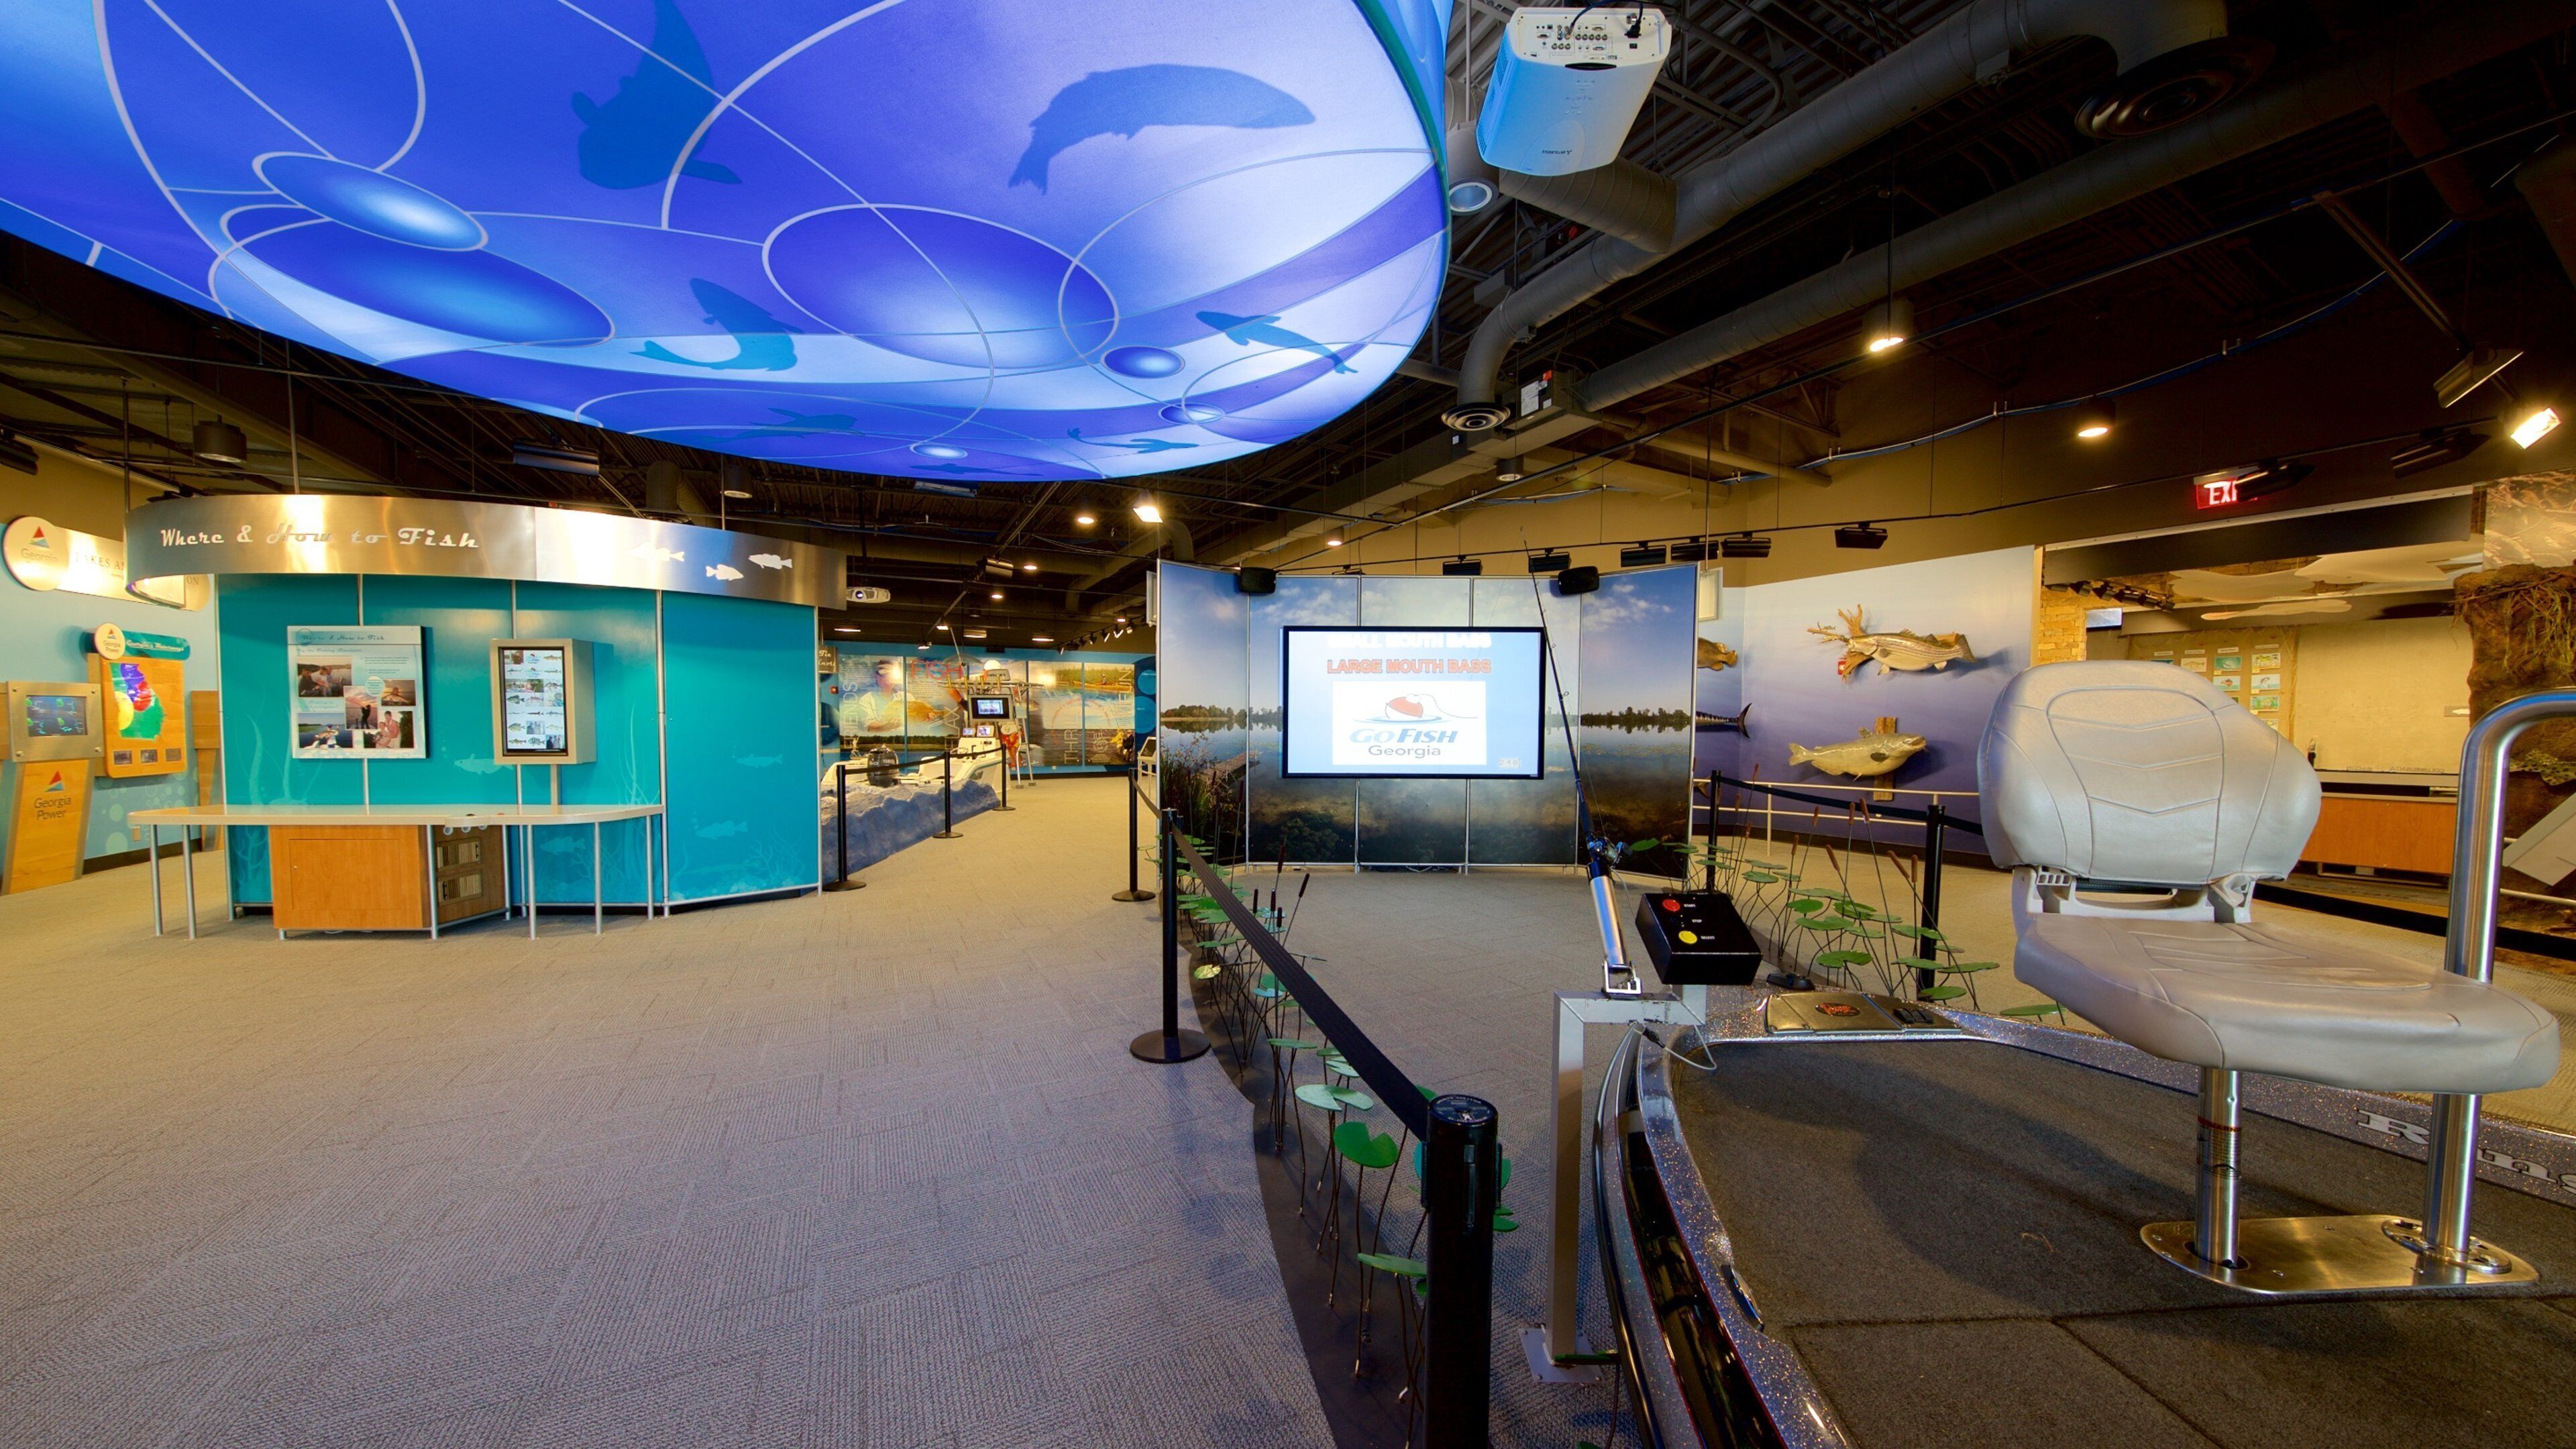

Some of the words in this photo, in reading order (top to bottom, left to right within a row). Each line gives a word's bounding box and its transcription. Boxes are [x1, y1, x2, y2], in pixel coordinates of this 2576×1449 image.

[2209, 480, 2237, 504] EXI
[160, 528, 225, 547] Where
[236, 525, 254, 543] &
[266, 523, 333, 544] How
[351, 529, 388, 543] to
[398, 527, 479, 548] Fish
[1327, 659, 1383, 674] LARGE
[1386, 659, 1444, 674] MOUTH
[1447, 659, 1492, 674] BASS
[1368, 745, 1441, 759] Georgia
[34, 796, 71, 808] Georgia
[37, 810, 66, 820] Power
